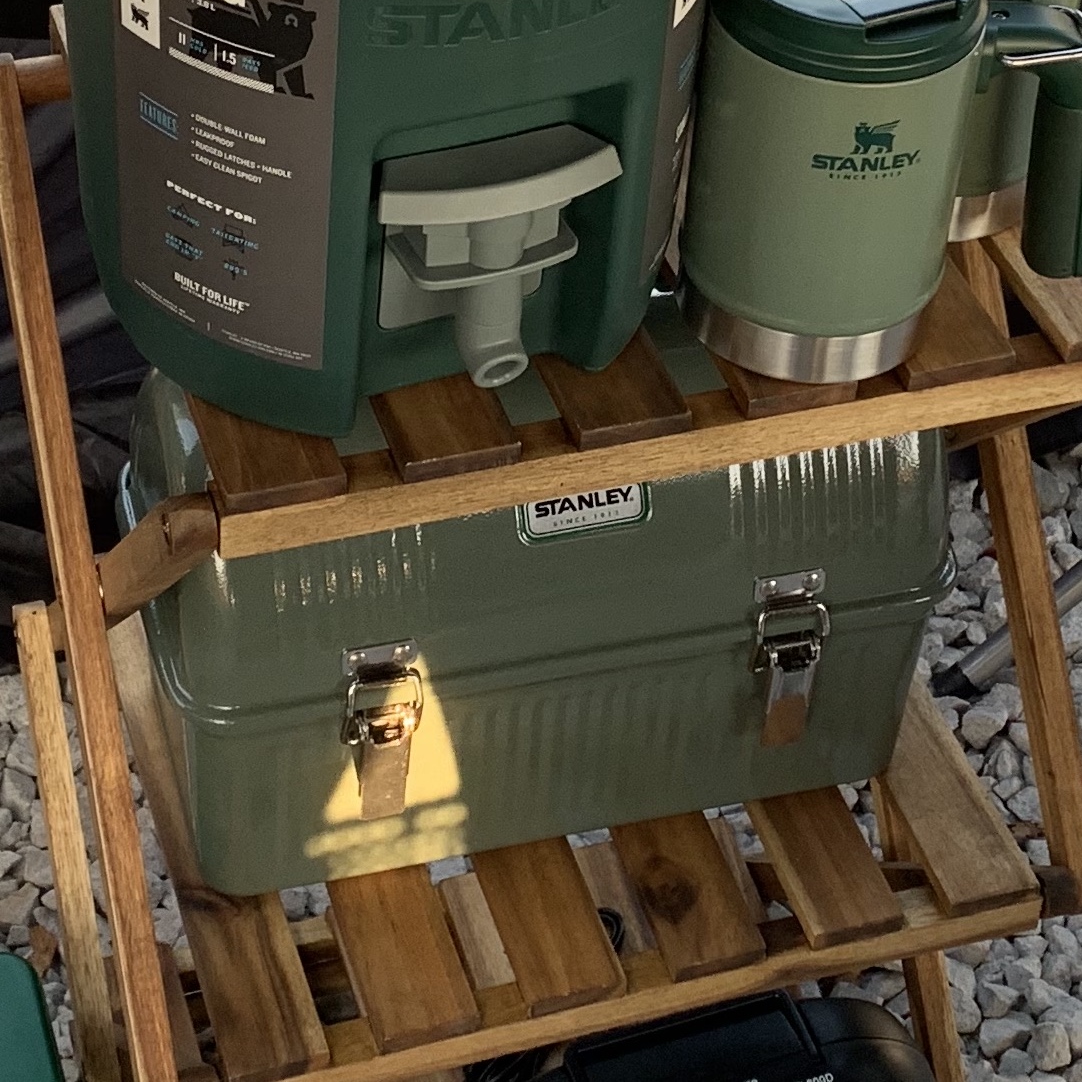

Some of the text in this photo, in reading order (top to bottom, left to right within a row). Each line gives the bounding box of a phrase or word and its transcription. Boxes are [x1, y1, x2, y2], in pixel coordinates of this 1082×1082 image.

[178, 31, 186, 46] 11
[222, 49, 237, 67] 1.5
[195, 113, 267, 146] DOUBLE WALL FOAM
[195, 127, 236, 149] LEAKPROOF
[195, 154, 263, 185] EASY CLEAN SPIGOT
[224, 152, 256, 170] LATCHES
[262, 164, 293, 179] HANDLE
[811, 149, 921, 172] STANLEY
[829, 171, 866, 181] SINCE
[166, 179, 223, 213] PERFECT
[174, 271, 200, 293] BUILT
[202, 286, 222, 303] FOR
[534, 485, 633, 518] STANLEY
[553, 516, 587, 527] SINCE
